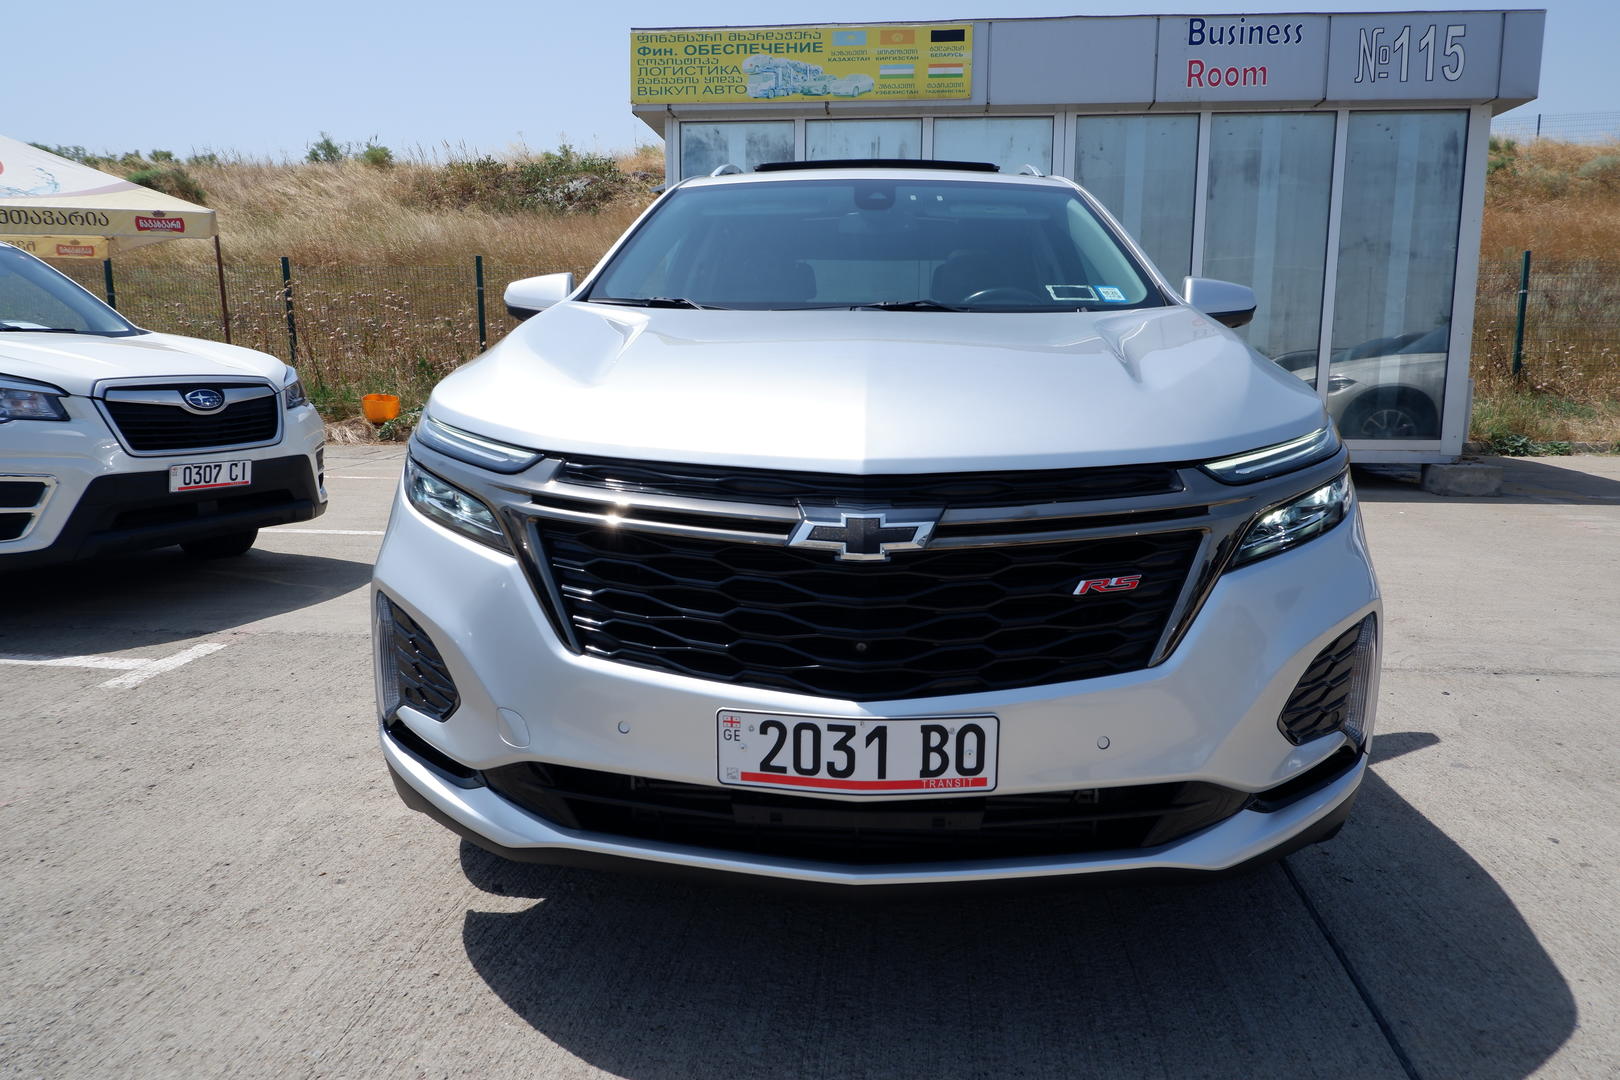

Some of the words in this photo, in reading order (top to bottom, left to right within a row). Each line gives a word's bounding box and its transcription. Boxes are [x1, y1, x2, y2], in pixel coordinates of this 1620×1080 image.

[1187, 17, 1304, 46] Business
[637, 46, 678, 56] Фин.
[684, 41, 824, 55] ОБЕСПЕЧЕНИЕ
[638, 65, 741, 77] ЛОГИСТИКА
[1186, 59, 1269, 88] Room
[637, 86, 697, 96] ВЫКУП
[702, 85, 748, 95] АВТО
[183, 463, 222, 486] 0307
[229, 462, 246, 482] CI
[1073, 574, 1142, 595] RS
[723, 728, 741, 741] GE
[759, 719, 888, 780] 2031
[922, 777, 973, 789] TRANSIT
